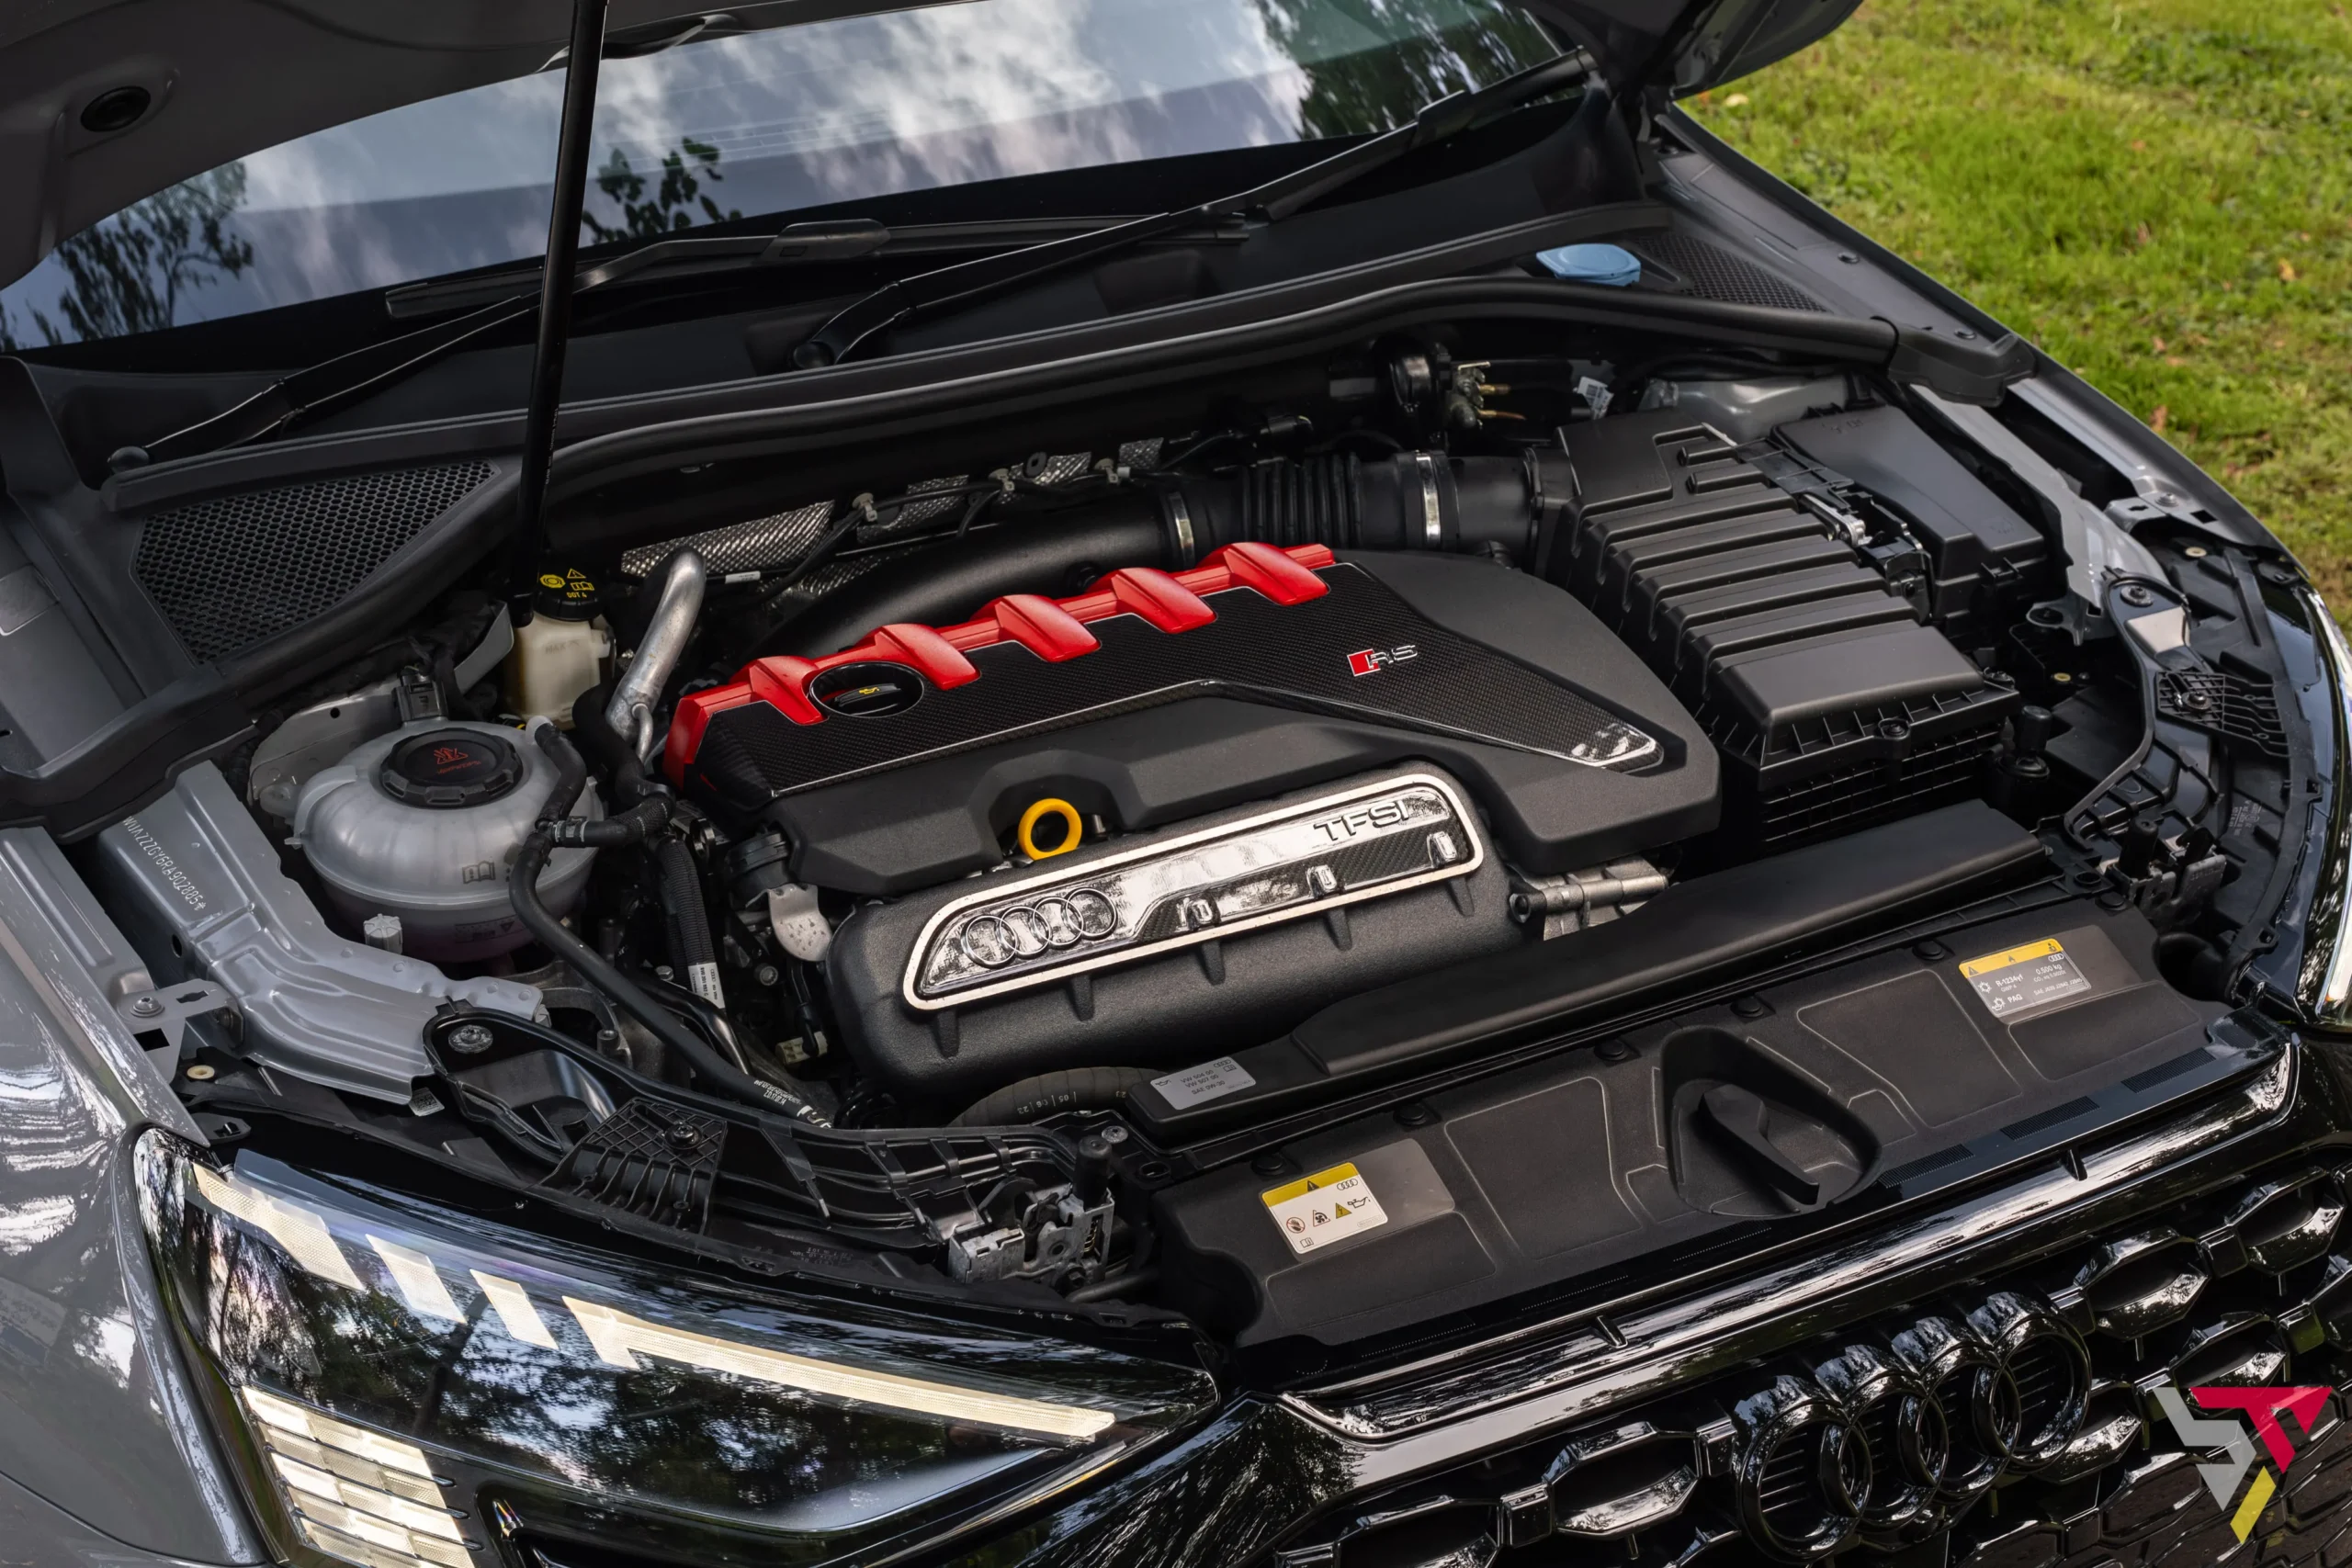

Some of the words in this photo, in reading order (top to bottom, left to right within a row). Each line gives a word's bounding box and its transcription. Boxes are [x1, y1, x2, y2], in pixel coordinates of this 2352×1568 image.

[1364, 645, 1418, 670] RS
[1313, 799, 1409, 841] TFSI
[2007, 993, 2023, 1003] PAG
[1191, 1087, 1205, 1095] SAE
